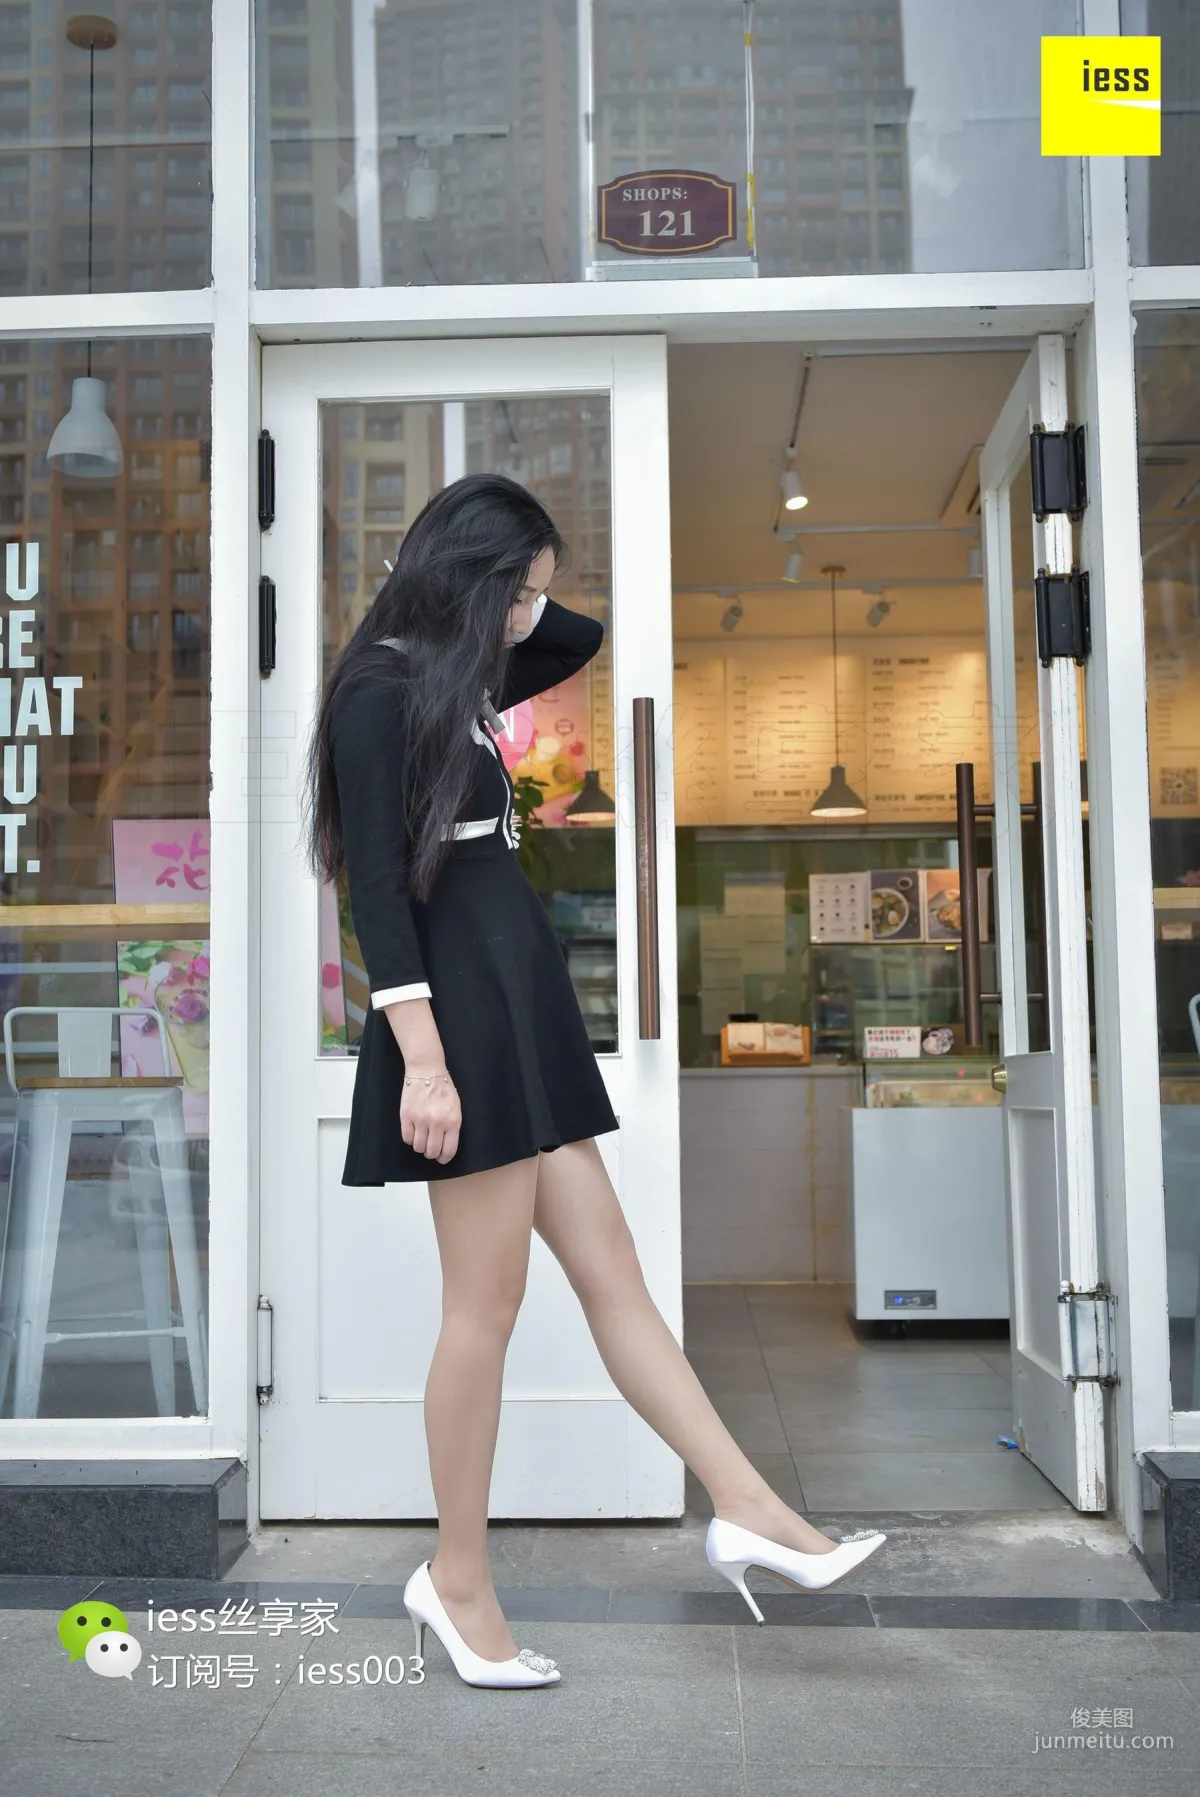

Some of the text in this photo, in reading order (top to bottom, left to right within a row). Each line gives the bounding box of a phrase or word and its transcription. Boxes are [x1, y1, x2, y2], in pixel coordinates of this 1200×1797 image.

[622, 187, 688, 202] SHOPS:
[639, 209, 696, 237] 121
[0, 609, 36, 669] E
